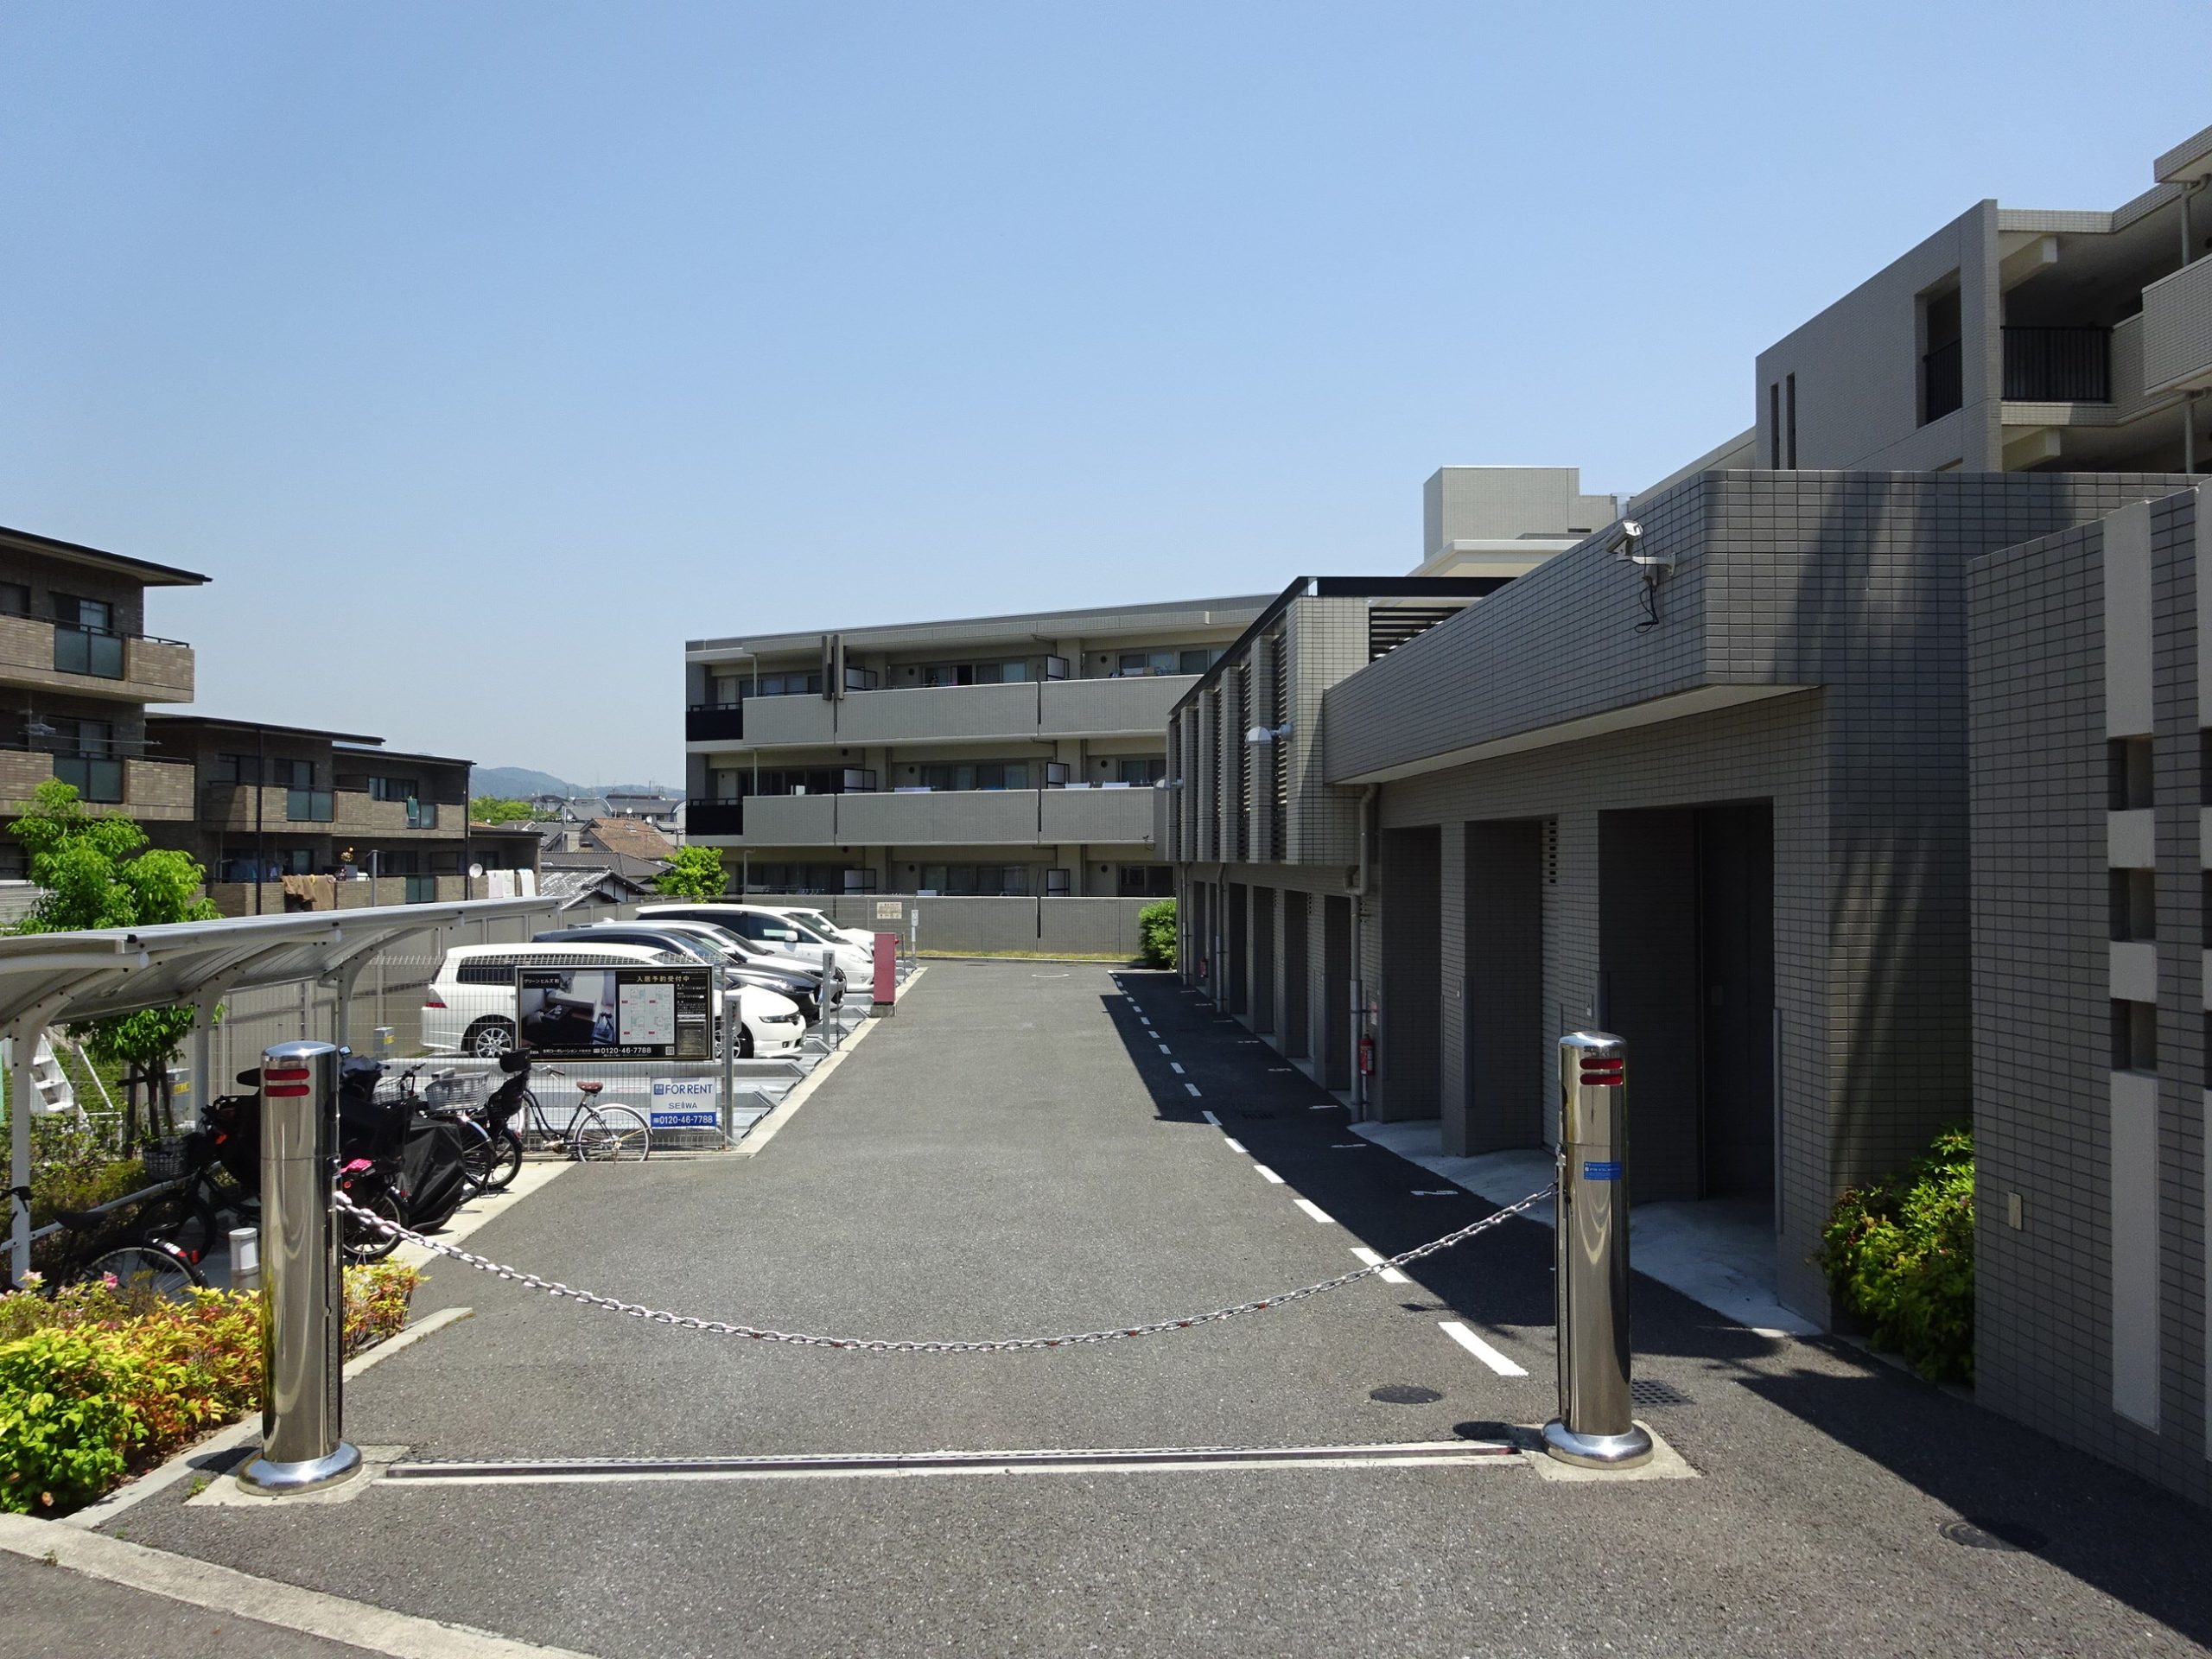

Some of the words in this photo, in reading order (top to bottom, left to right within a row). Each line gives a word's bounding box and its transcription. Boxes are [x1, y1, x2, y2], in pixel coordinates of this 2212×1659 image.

[665, 1084, 686, 1095] FOR
[687, 1084, 713, 1095] RENT
[668, 1101, 698, 1109] SEIWA
[659, 1115, 714, 1125] 0120-46-7788
